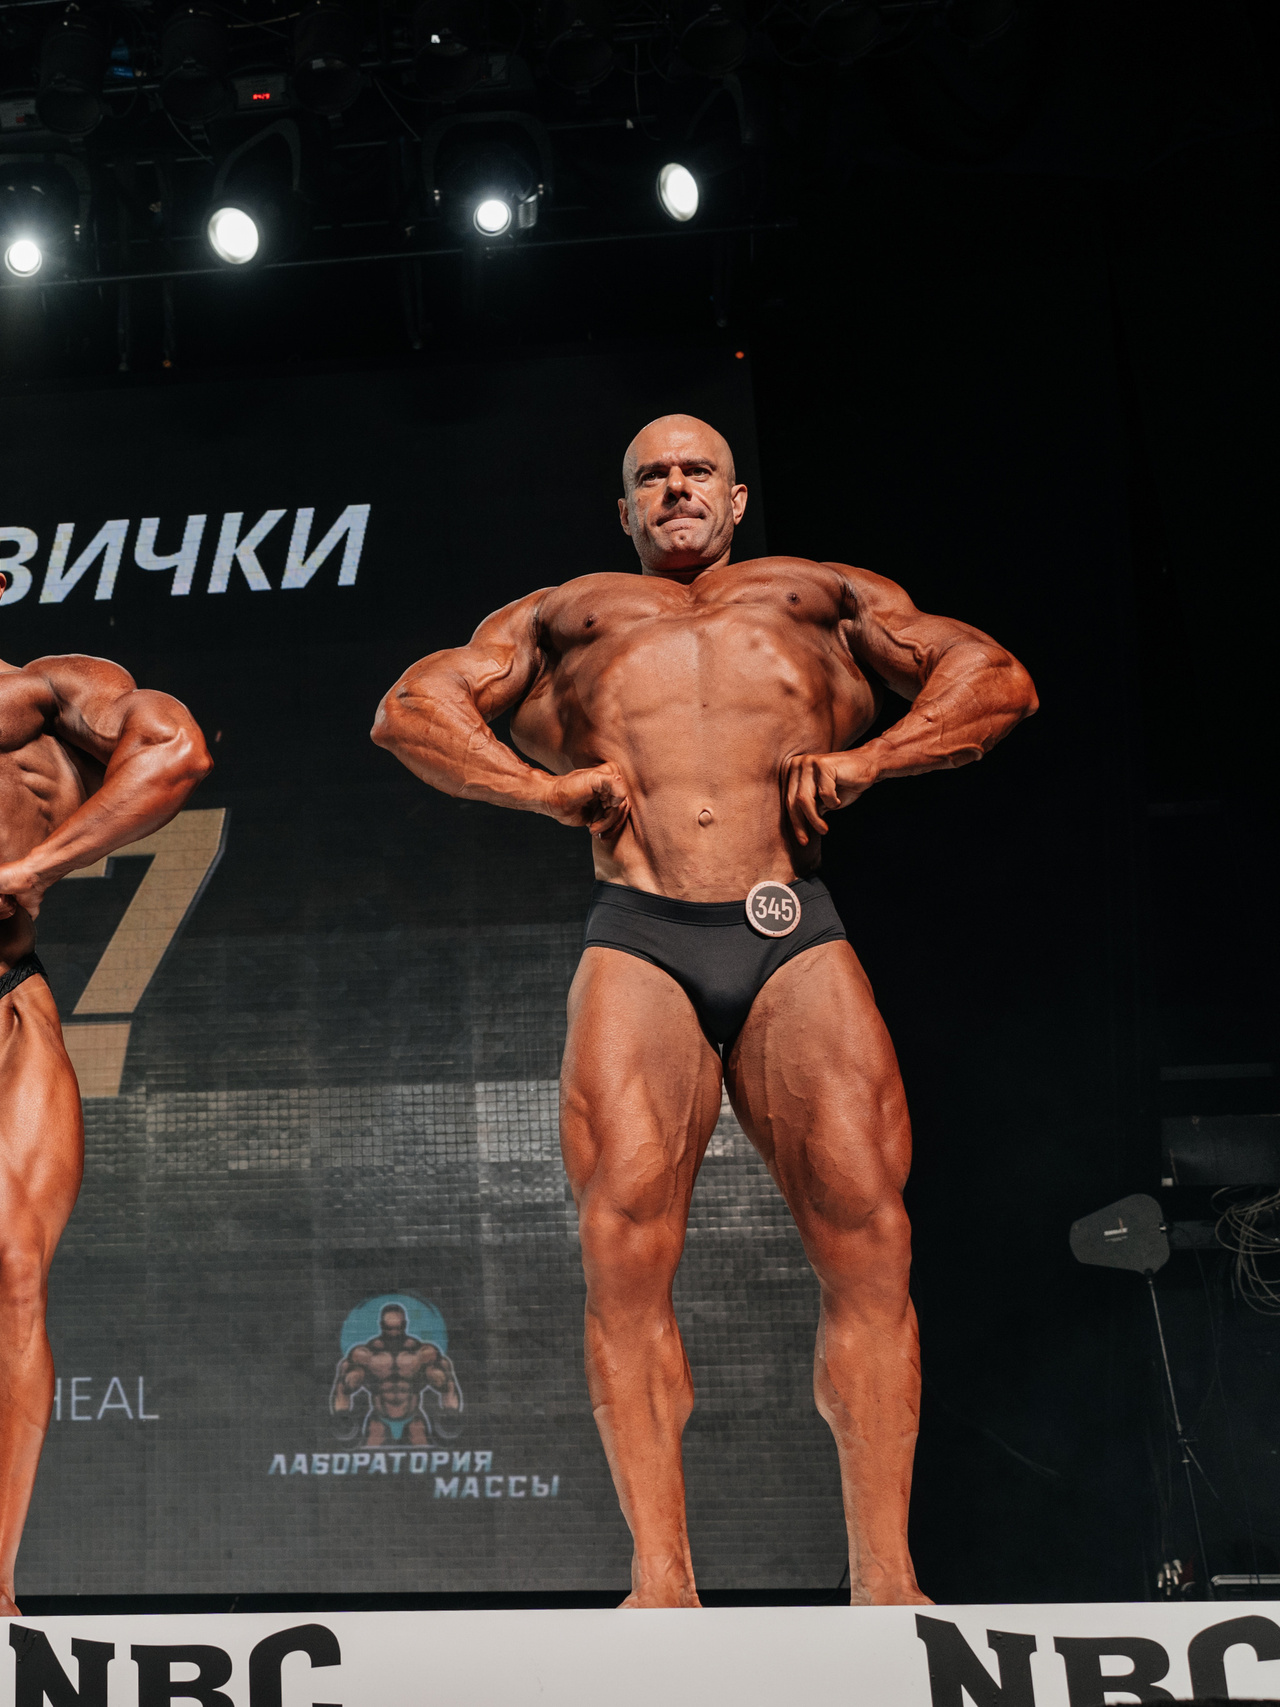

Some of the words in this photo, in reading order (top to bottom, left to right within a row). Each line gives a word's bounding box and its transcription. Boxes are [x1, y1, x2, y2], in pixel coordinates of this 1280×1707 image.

[755, 895, 793, 922] 345
[268, 1450, 494, 1475] ЛАБОРАТОРИЯ
[433, 1475, 560, 1499] МАССЫ
[9, 1623, 342, 1707] NBC
[915, 1613, 1280, 1707] NBC
